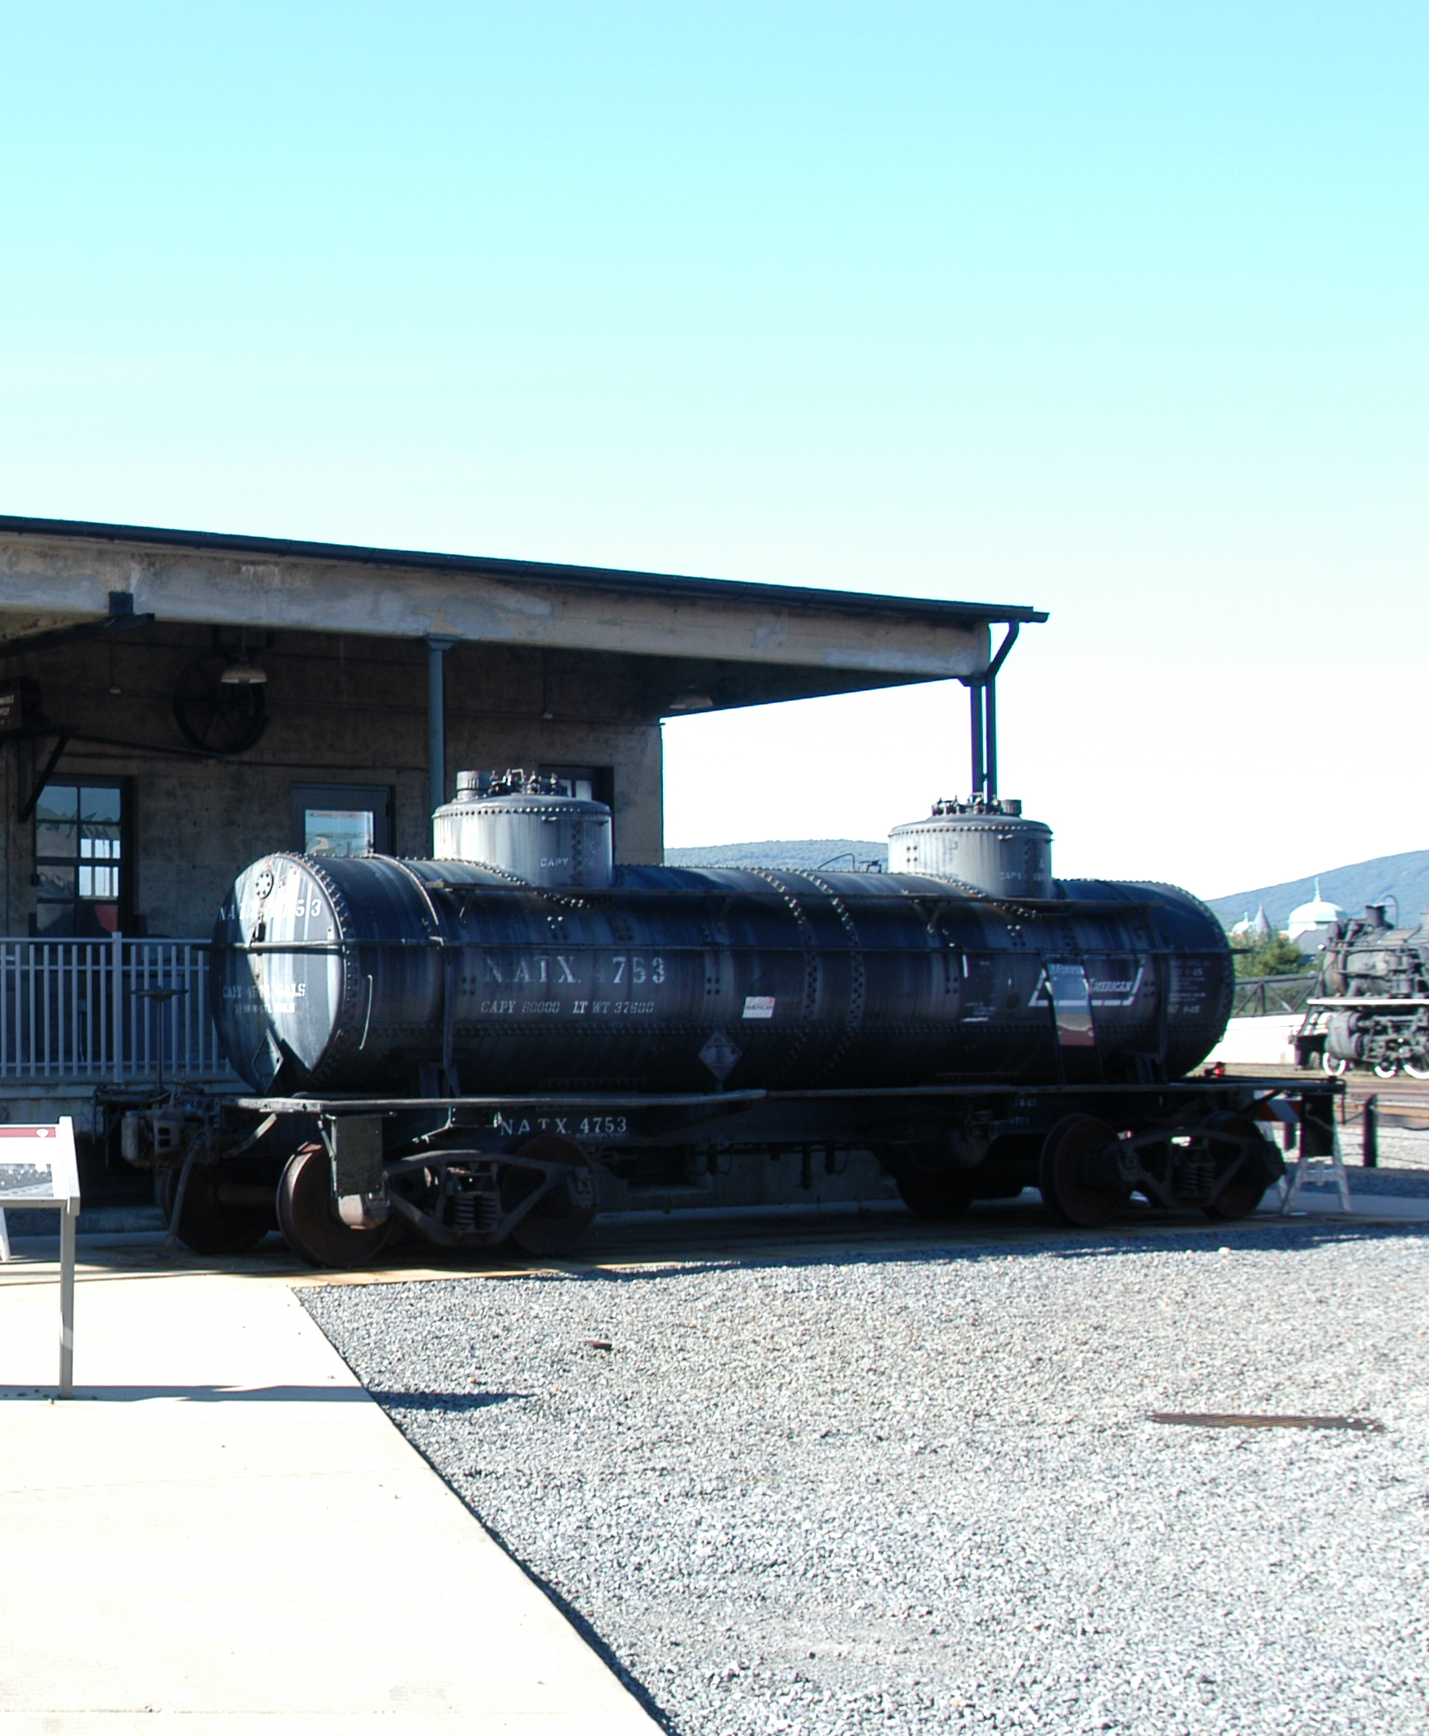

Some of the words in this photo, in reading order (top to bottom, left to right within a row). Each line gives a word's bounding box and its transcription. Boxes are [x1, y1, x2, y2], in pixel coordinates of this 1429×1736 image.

[539, 857, 569, 868] CAPY
[597, 955, 667, 984] 753
[481, 1001, 517, 1014] CAPY
[572, 1001, 589, 1014] LT
[591, 1001, 610, 1014] WT
[579, 1116, 628, 1134] 4753
